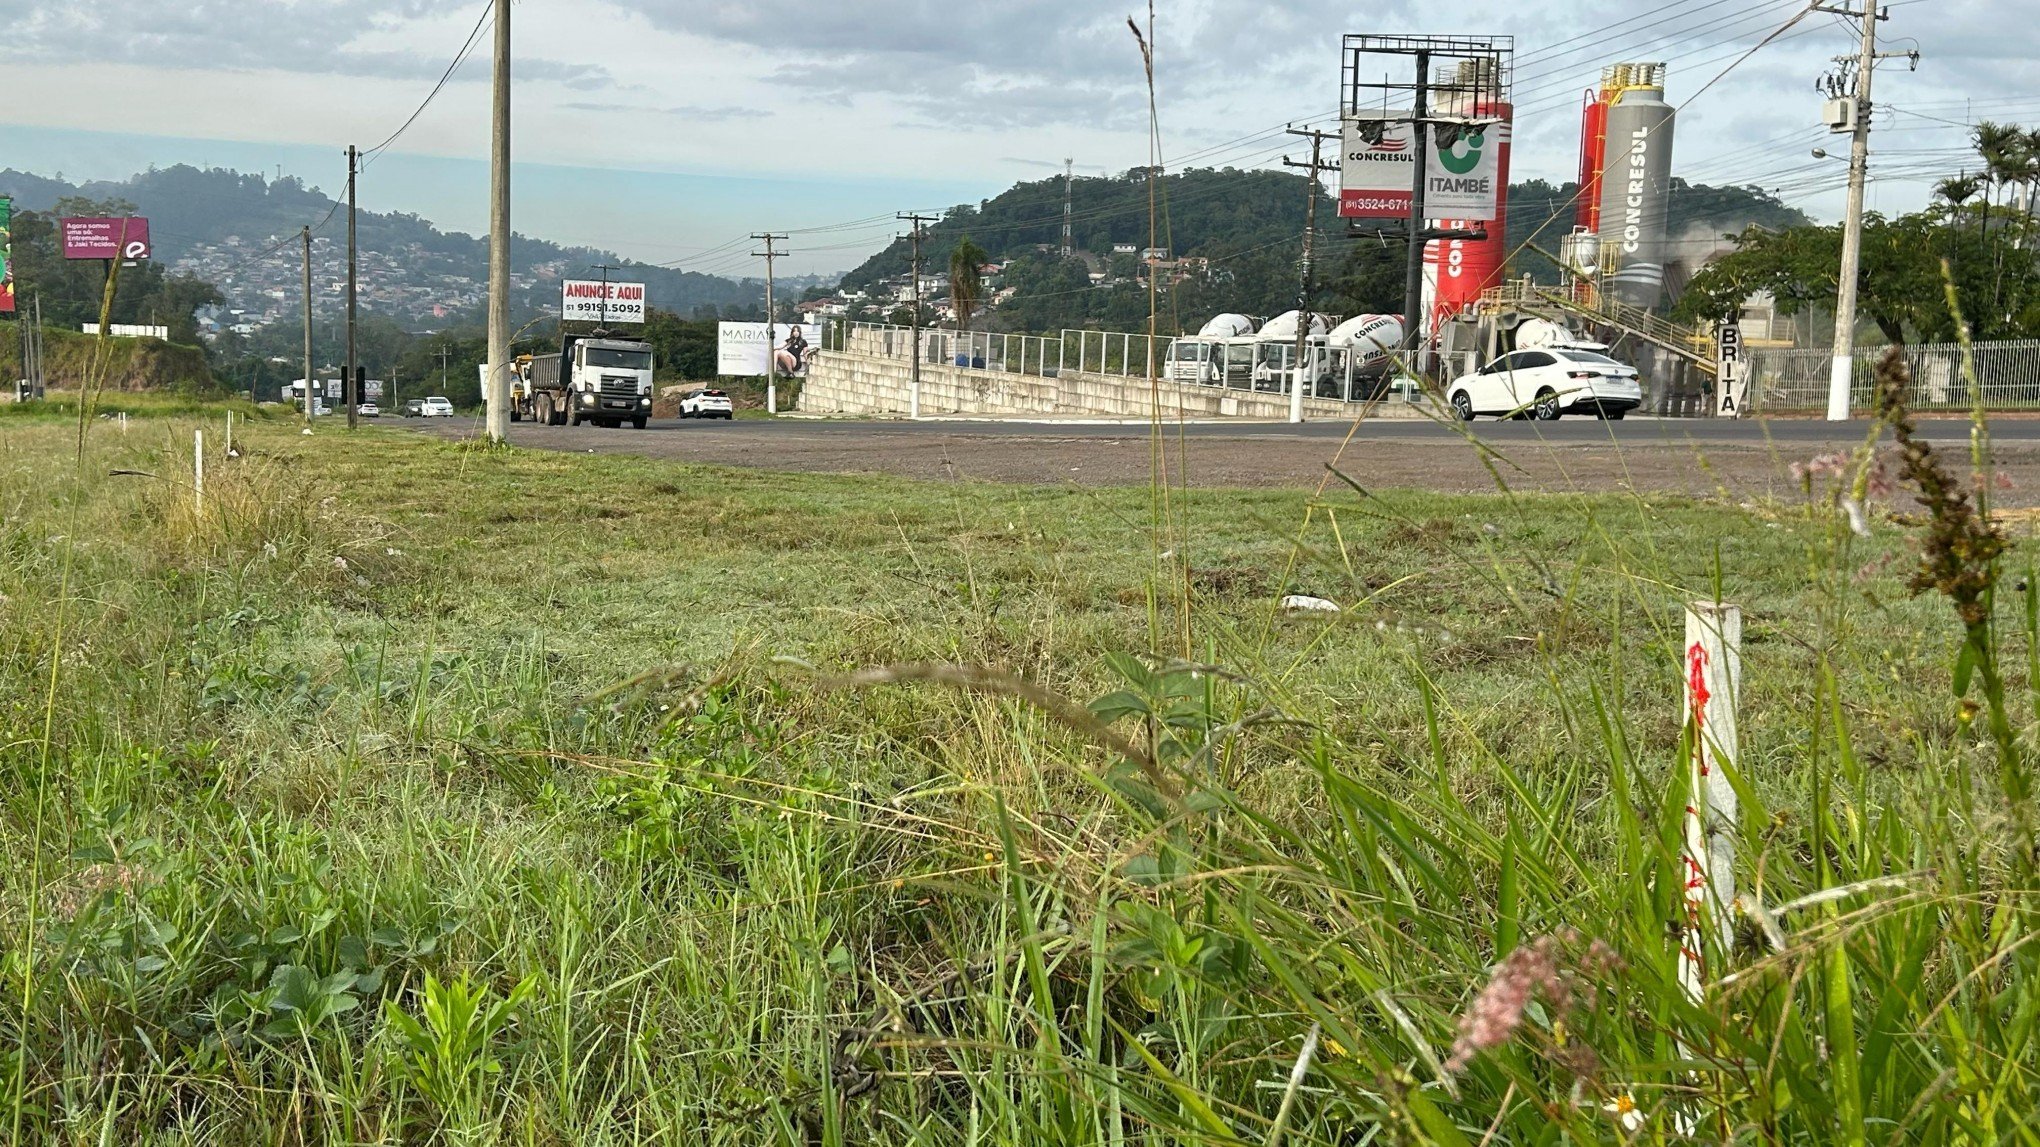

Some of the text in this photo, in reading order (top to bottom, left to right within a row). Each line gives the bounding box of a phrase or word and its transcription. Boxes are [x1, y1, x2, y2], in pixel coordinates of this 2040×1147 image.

[1349, 153, 1413, 162] CONCRESUL
[1429, 176, 1489, 193] ITAMBÉ
[1623, 126, 1648, 253] CONCRESUL
[566, 283, 643, 300] ANUNCIE AQUI
[577, 302, 641, 313] 99191.5092
[722, 329, 769, 340] MARIA
[1721, 328, 1737, 411] BRITA
